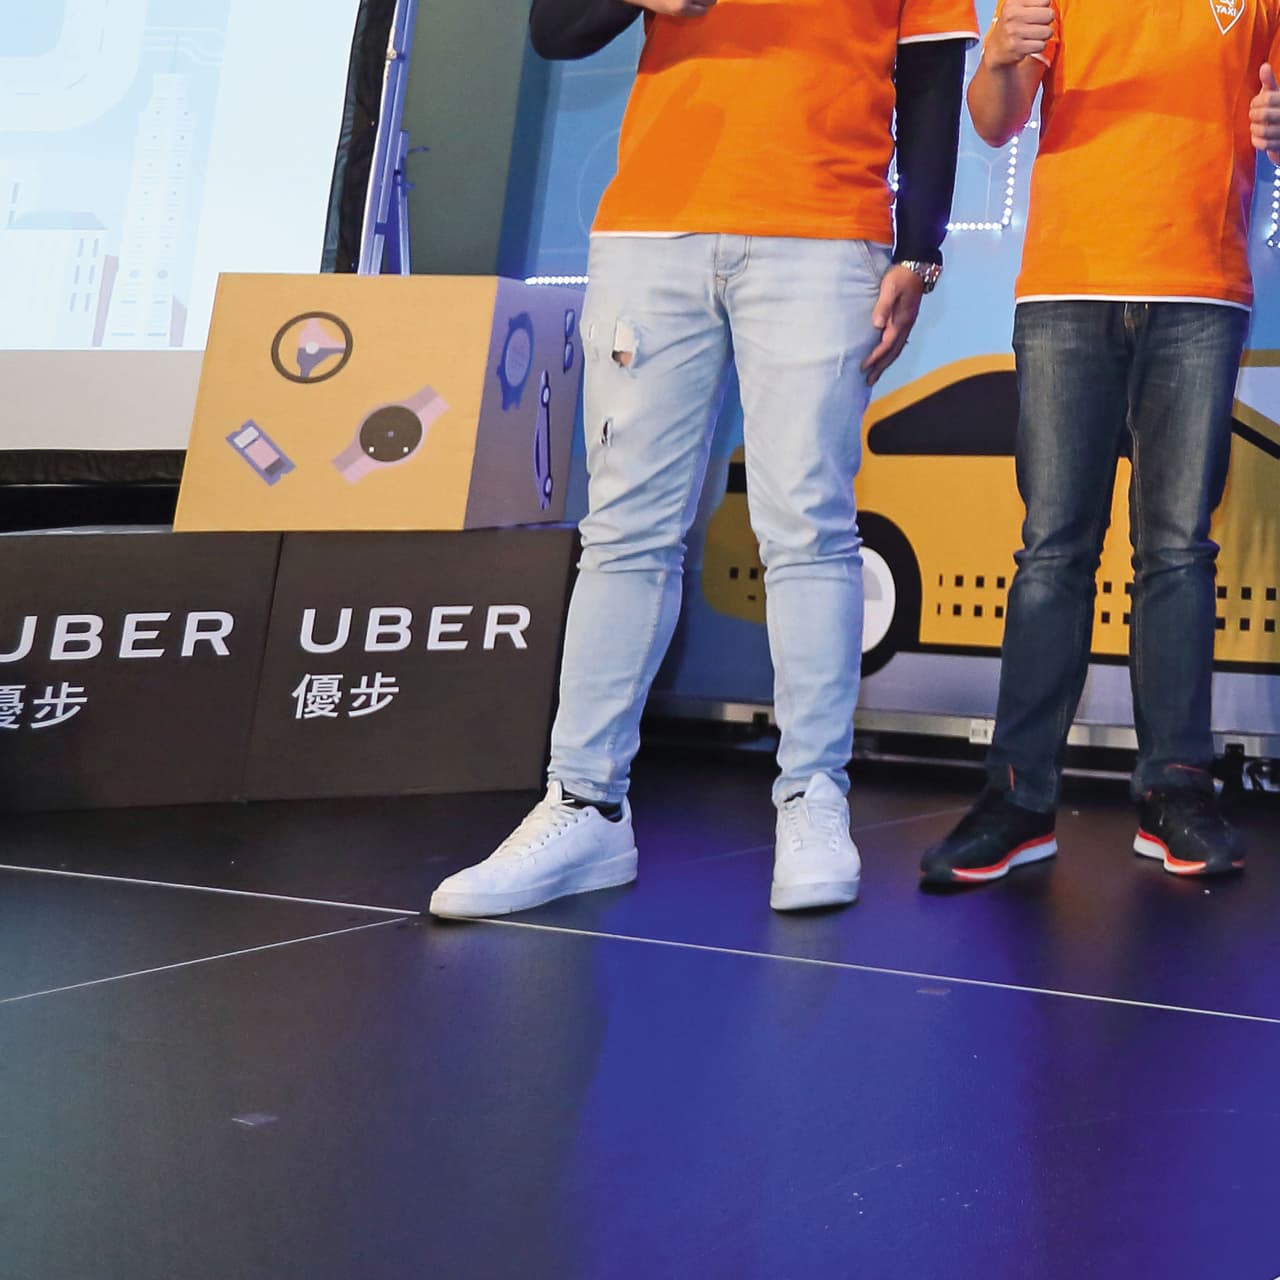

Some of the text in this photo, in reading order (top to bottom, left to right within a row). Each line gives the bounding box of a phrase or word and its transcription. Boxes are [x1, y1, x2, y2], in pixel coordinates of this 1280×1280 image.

[1216, 4, 1237, 17] TAXI
[0, 611, 235, 663] UBER
[300, 604, 531, 654] UBER
[291, 671, 400, 720] 優步
